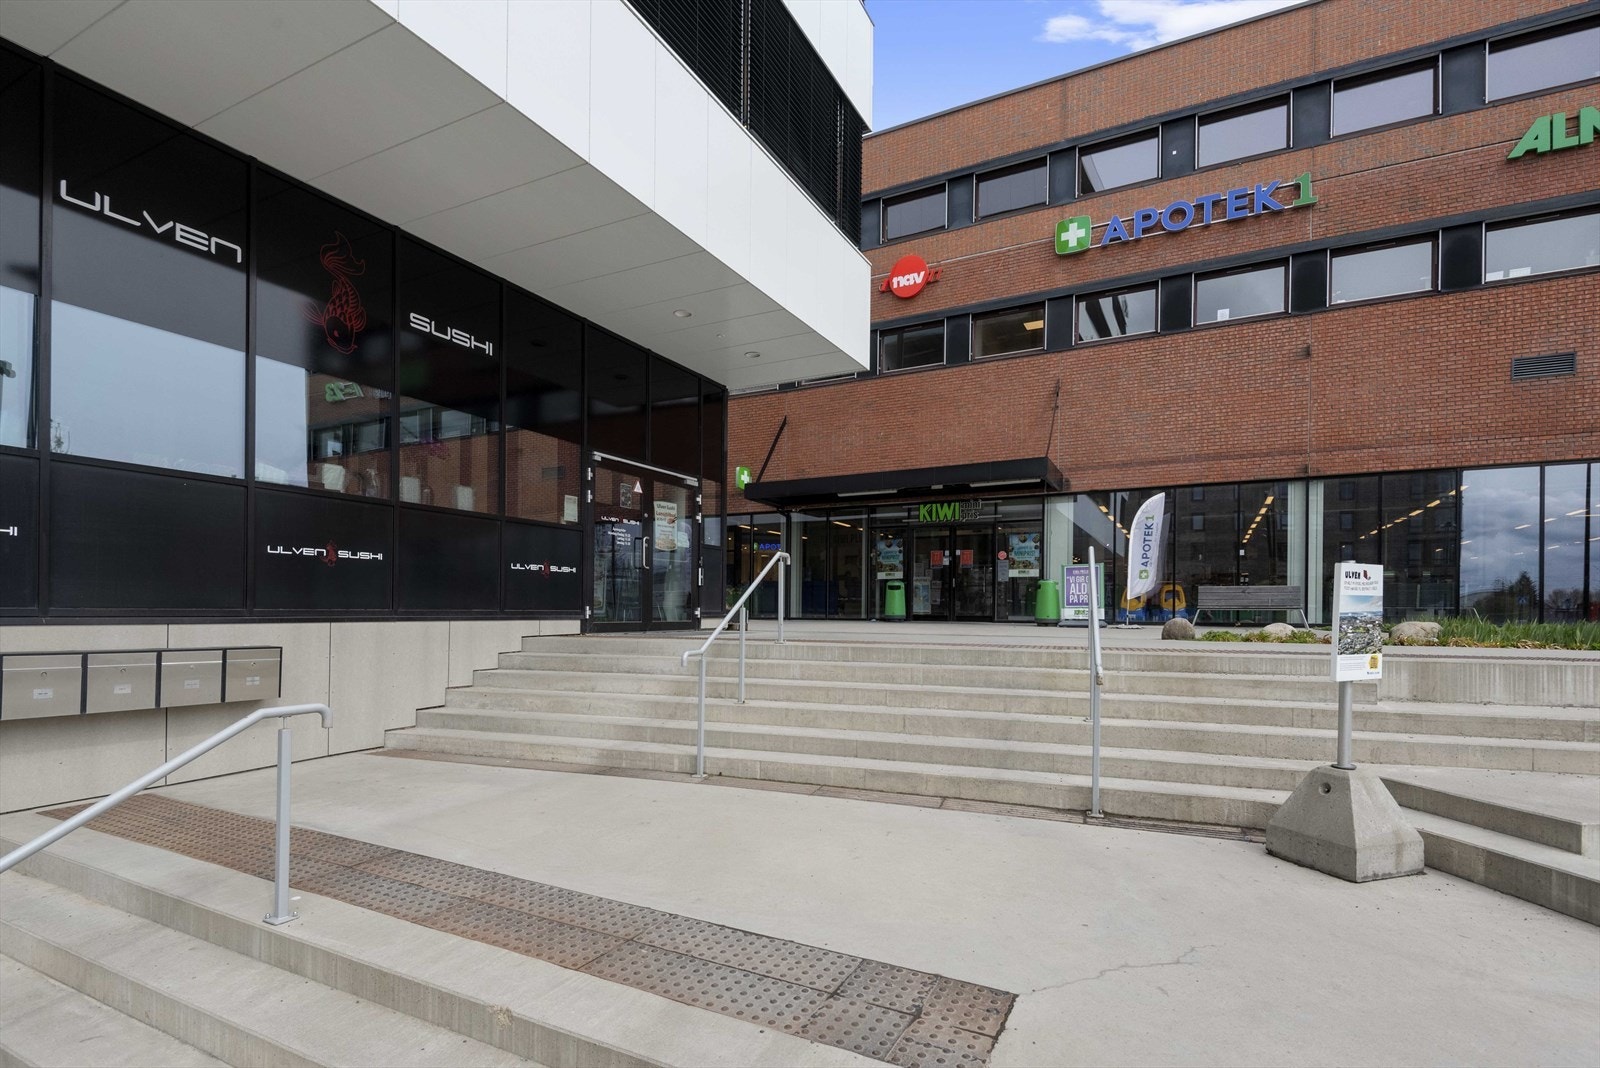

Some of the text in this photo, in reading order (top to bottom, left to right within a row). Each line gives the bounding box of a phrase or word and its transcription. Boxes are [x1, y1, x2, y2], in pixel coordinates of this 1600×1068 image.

[60, 179, 242, 263] ULVEN
[1101, 172, 1318, 247] APOTEK 1
[409, 312, 493, 356] SUSHI
[919, 502, 960, 522] KIWI
[267, 545, 383, 560] ULVEN SUSHI
[1140, 522, 1154, 568] APOTEK
[549, 565, 577, 573] SUSHI
[1069, 582, 1089, 595] ALD
